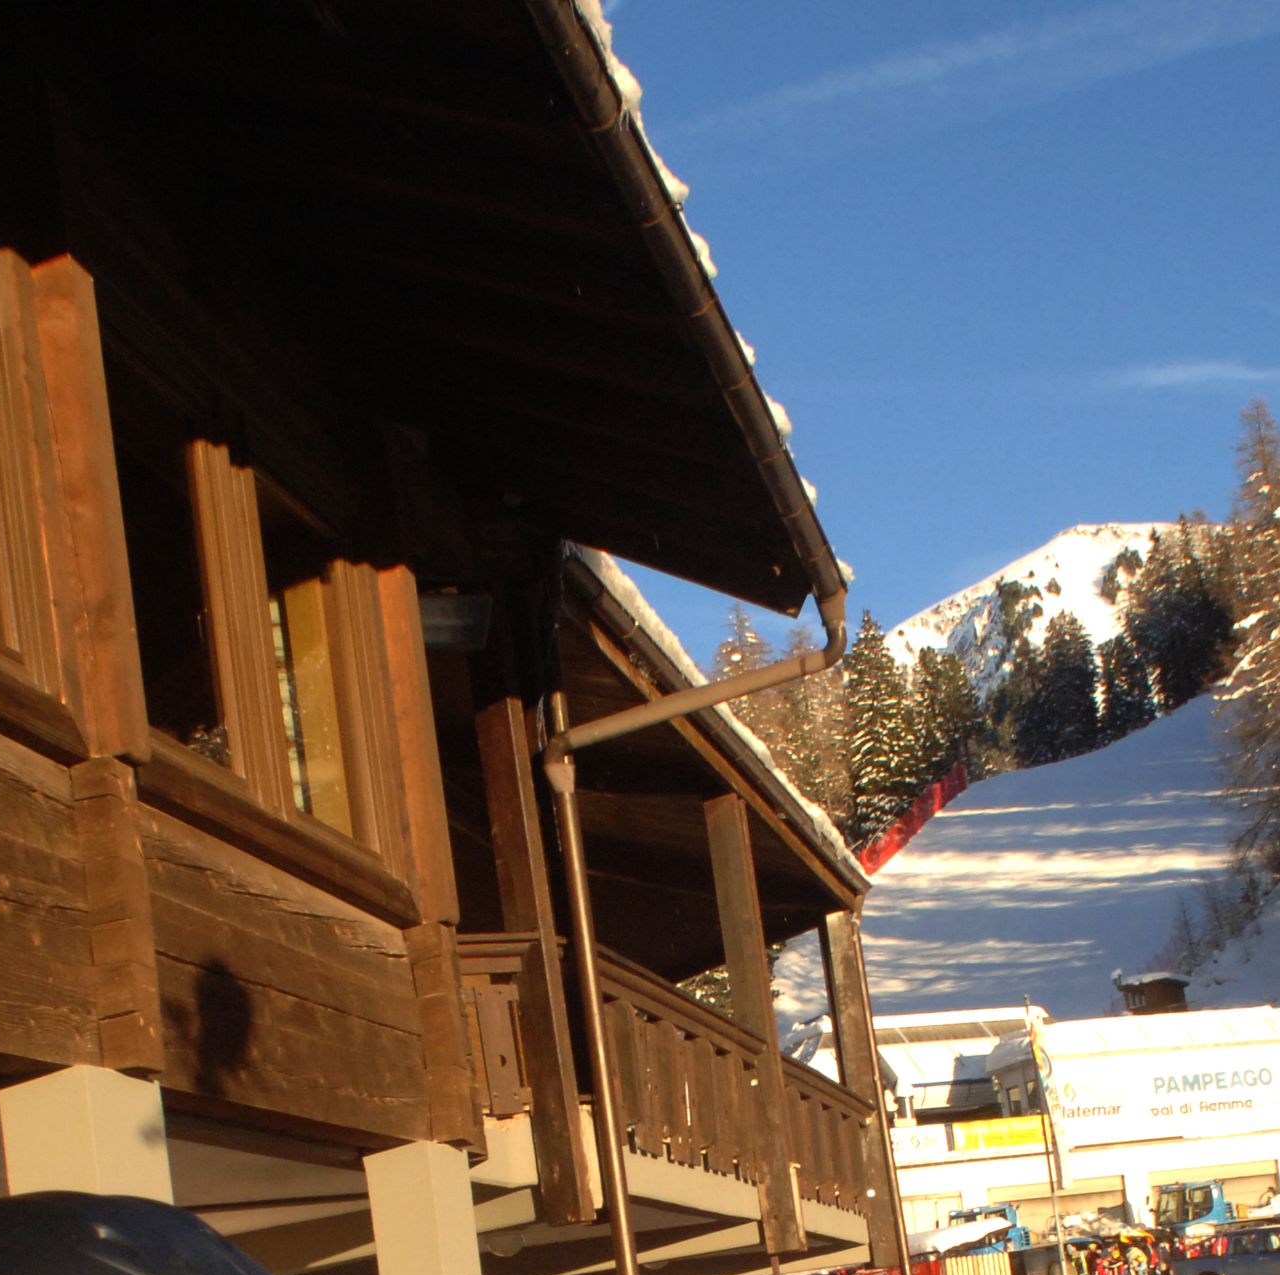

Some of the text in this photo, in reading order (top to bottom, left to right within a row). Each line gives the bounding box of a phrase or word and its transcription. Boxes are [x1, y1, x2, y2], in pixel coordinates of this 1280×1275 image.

[1153, 1068, 1273, 1094] PAMPEAGO
[1062, 1103, 1122, 1119] latemar
[1179, 1102, 1193, 1115] di
